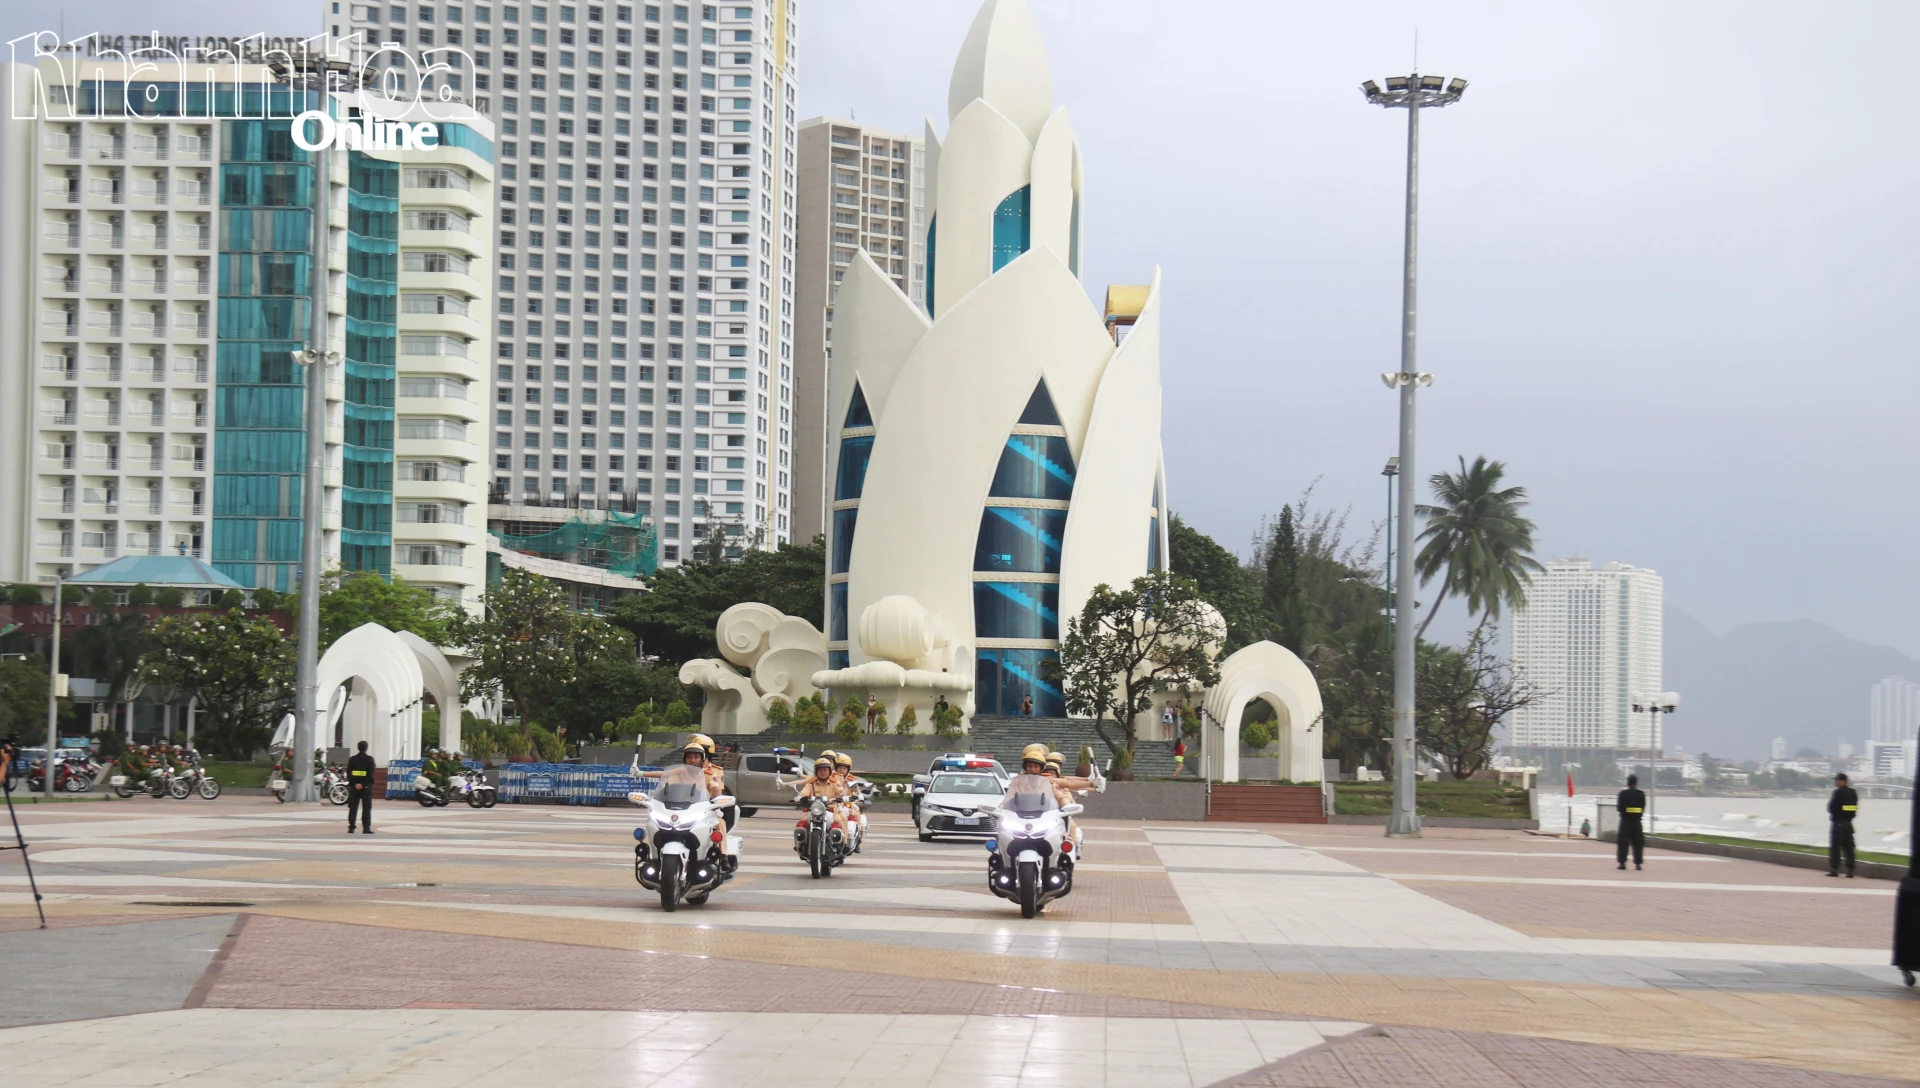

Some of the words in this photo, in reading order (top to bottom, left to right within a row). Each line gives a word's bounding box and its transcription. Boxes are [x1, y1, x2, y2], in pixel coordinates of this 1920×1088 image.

[88, 35, 125, 57] NHA
[129, 36, 190, 58] TRANG
[196, 37, 252, 58] LODGE
[259, 37, 315, 58] HOTEL
